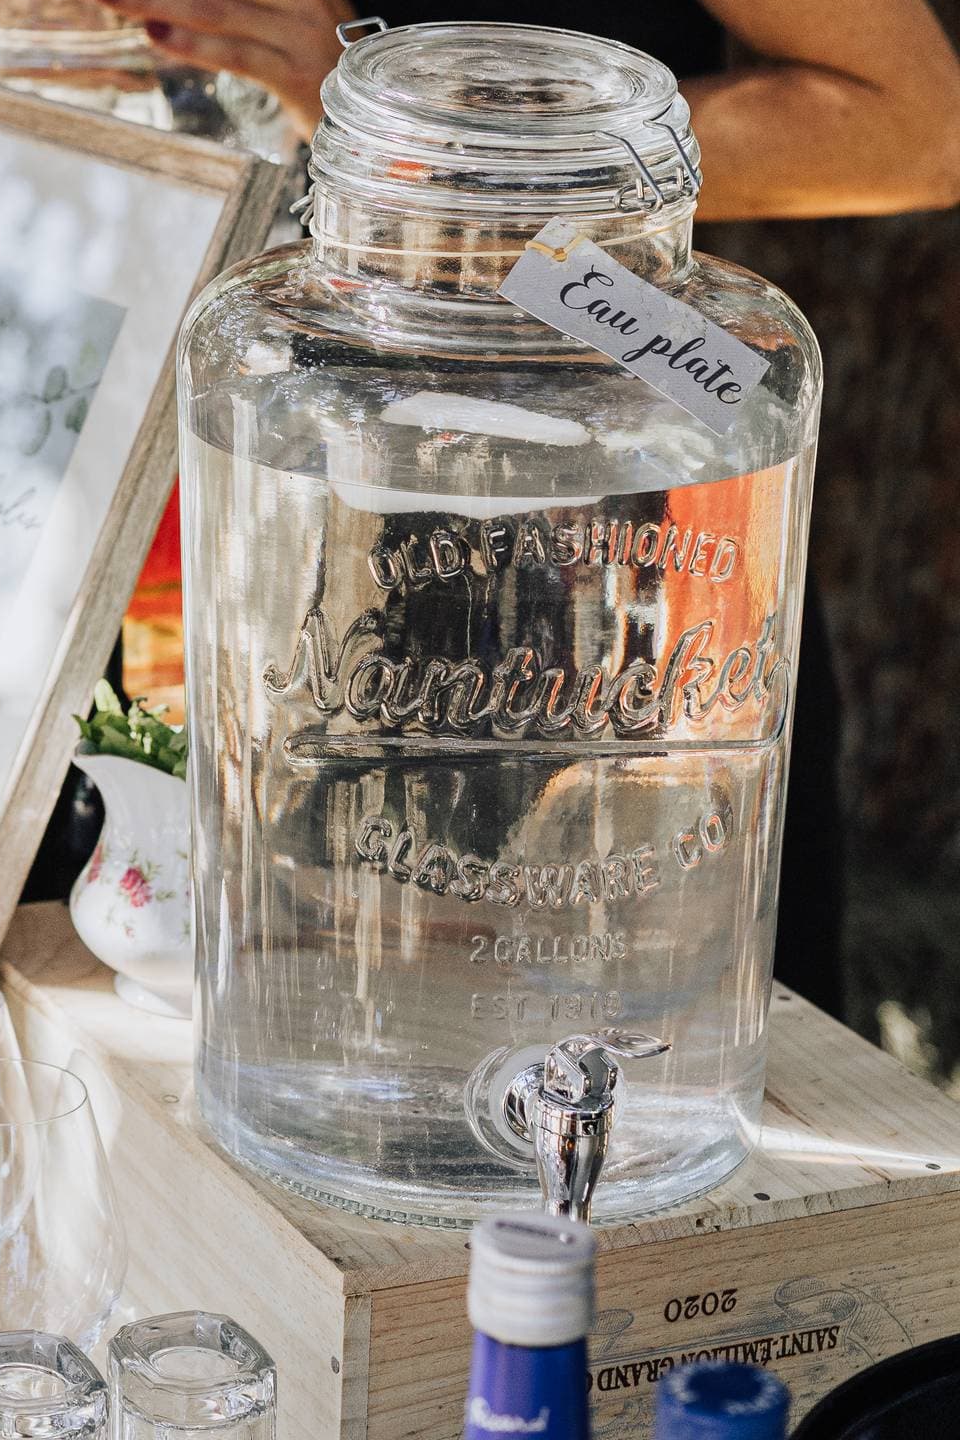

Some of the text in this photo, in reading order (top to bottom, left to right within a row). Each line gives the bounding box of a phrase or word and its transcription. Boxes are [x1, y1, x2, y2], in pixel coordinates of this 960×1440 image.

[559, 264, 742, 404] Eau plate
[367, 517, 741, 591] OLD FASHIONED
[262, 608, 790, 736] Nantucket
[354, 814, 662, 910] GLASSWARE
[493, 931, 629, 964] GALLONS
[471, 992, 527, 1023] EST
[664, 1288, 738, 1323] 2020
[597, 1356, 674, 1393] GRAND
